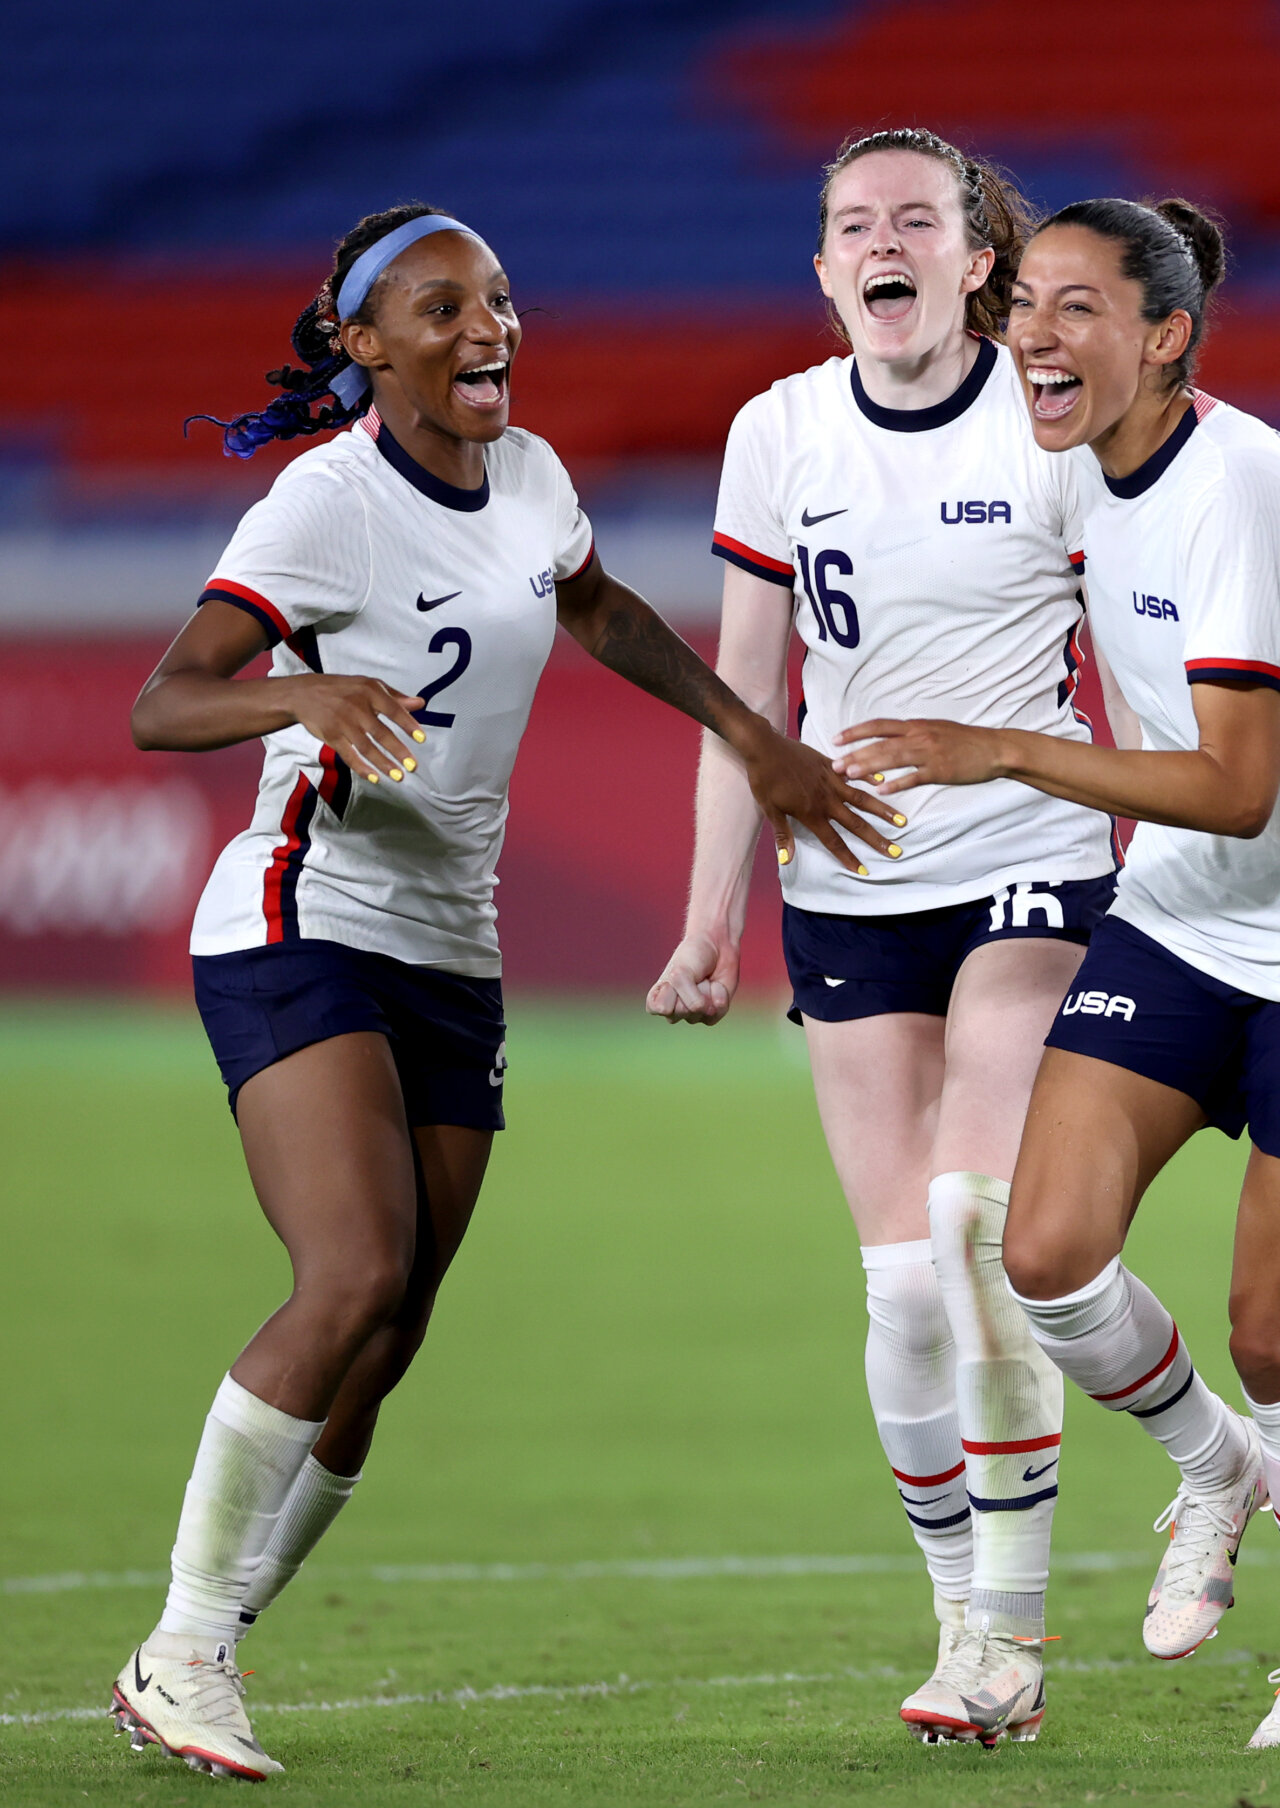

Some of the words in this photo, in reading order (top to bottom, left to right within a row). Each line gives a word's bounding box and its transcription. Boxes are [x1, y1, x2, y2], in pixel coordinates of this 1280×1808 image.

[941, 501, 1011, 524] USA
[529, 567, 554, 598] US
[797, 545, 860, 649] 16
[1132, 591, 1180, 622] USA
[410, 627, 472, 728] 2
[1062, 991, 1136, 1022] USA
